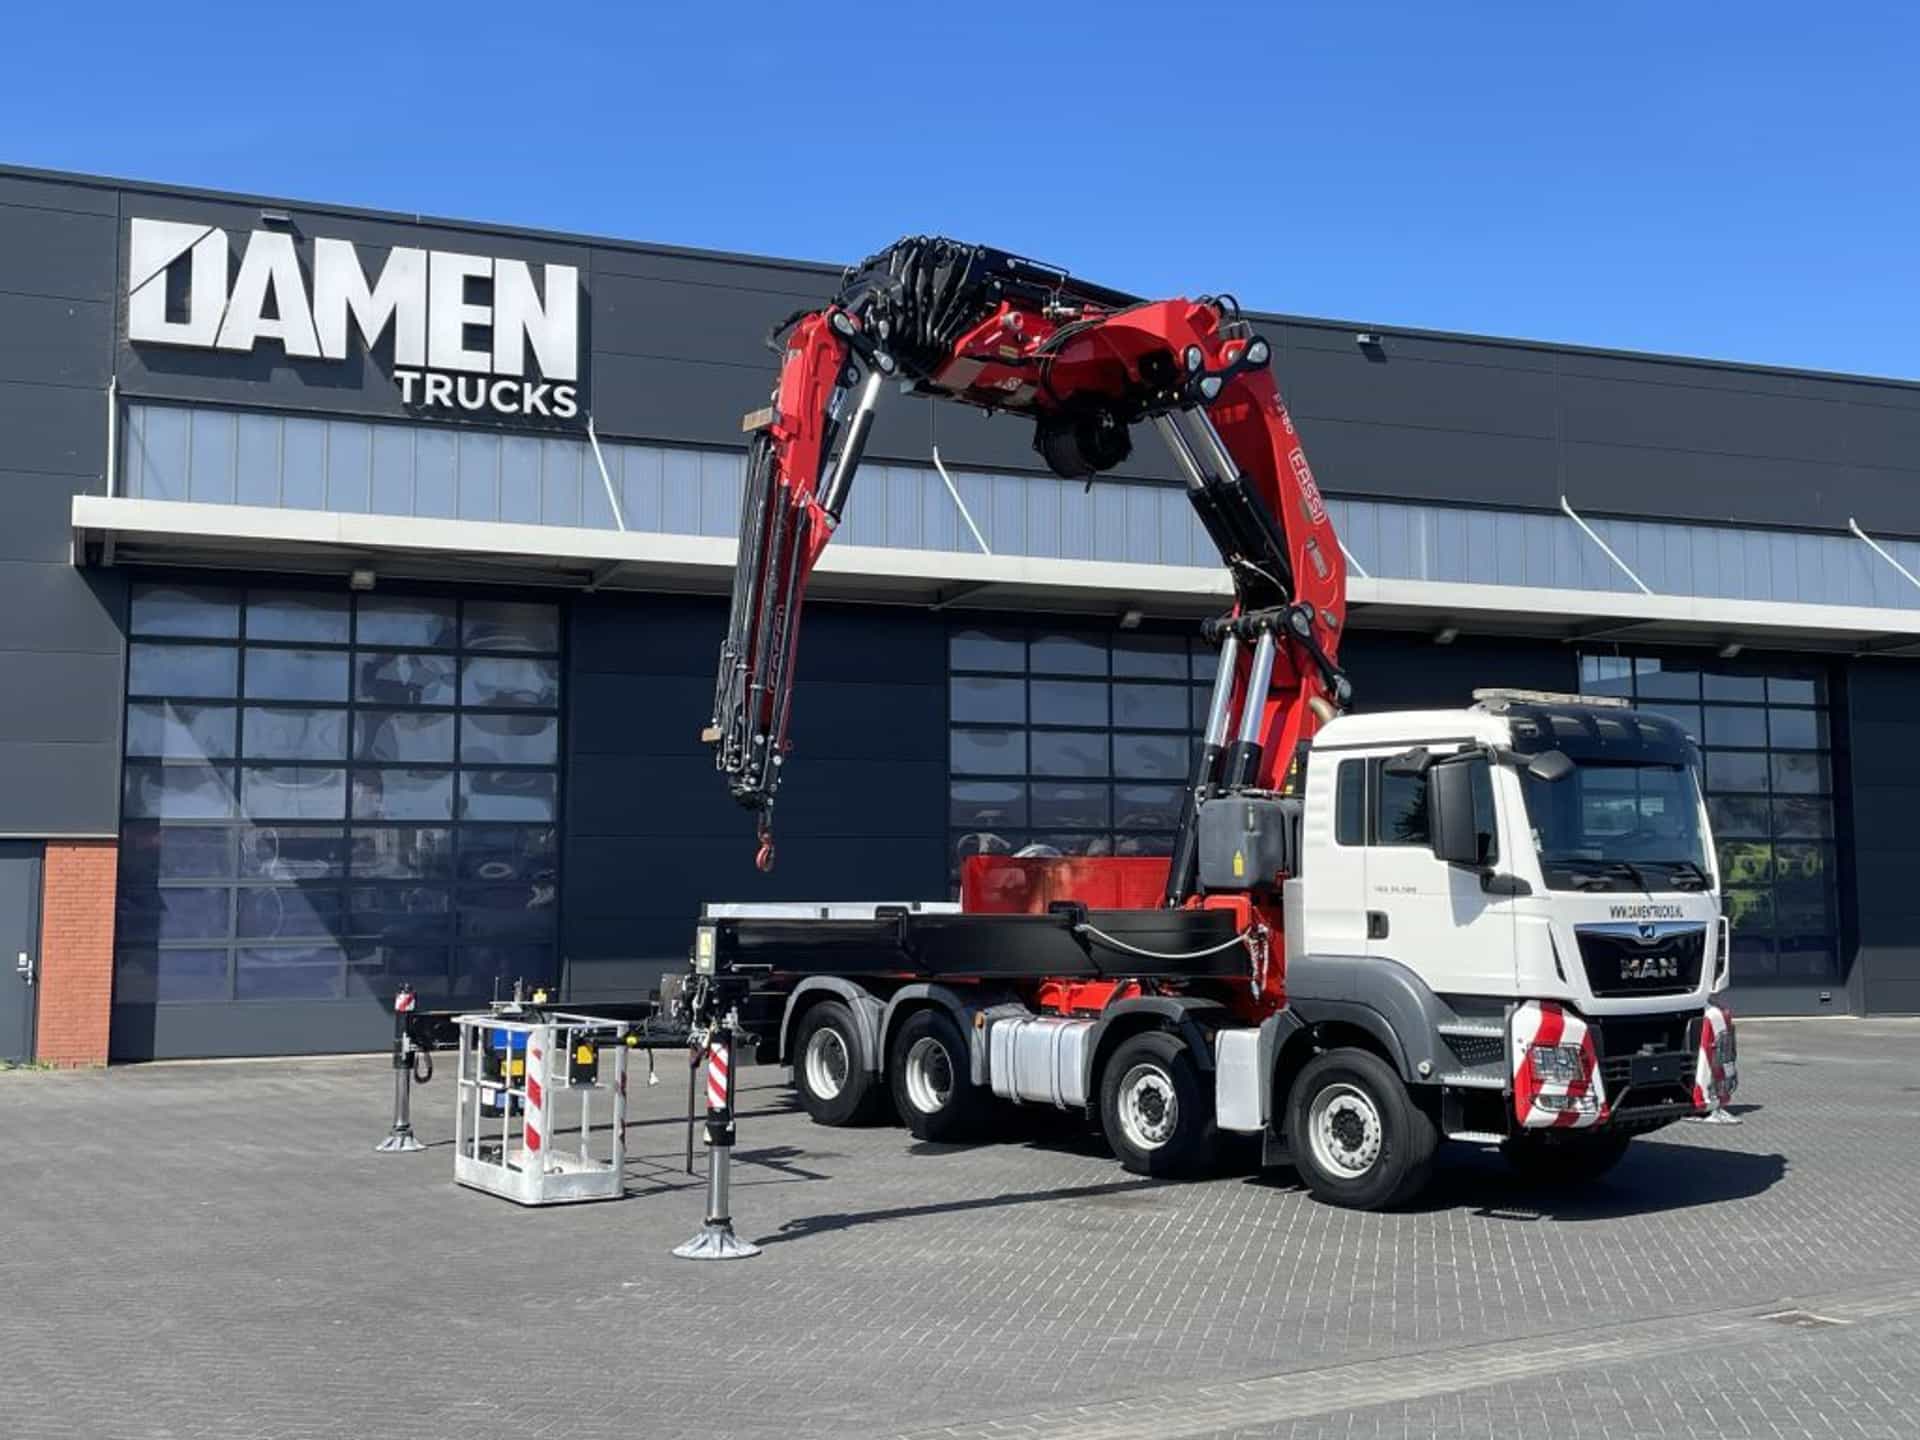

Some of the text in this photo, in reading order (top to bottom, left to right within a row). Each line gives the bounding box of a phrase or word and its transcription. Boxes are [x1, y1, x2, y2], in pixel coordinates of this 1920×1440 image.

[128, 217, 578, 381] DAMEN
[394, 370, 577, 418] TRUCKS
[1620, 957, 1678, 980] MAN
